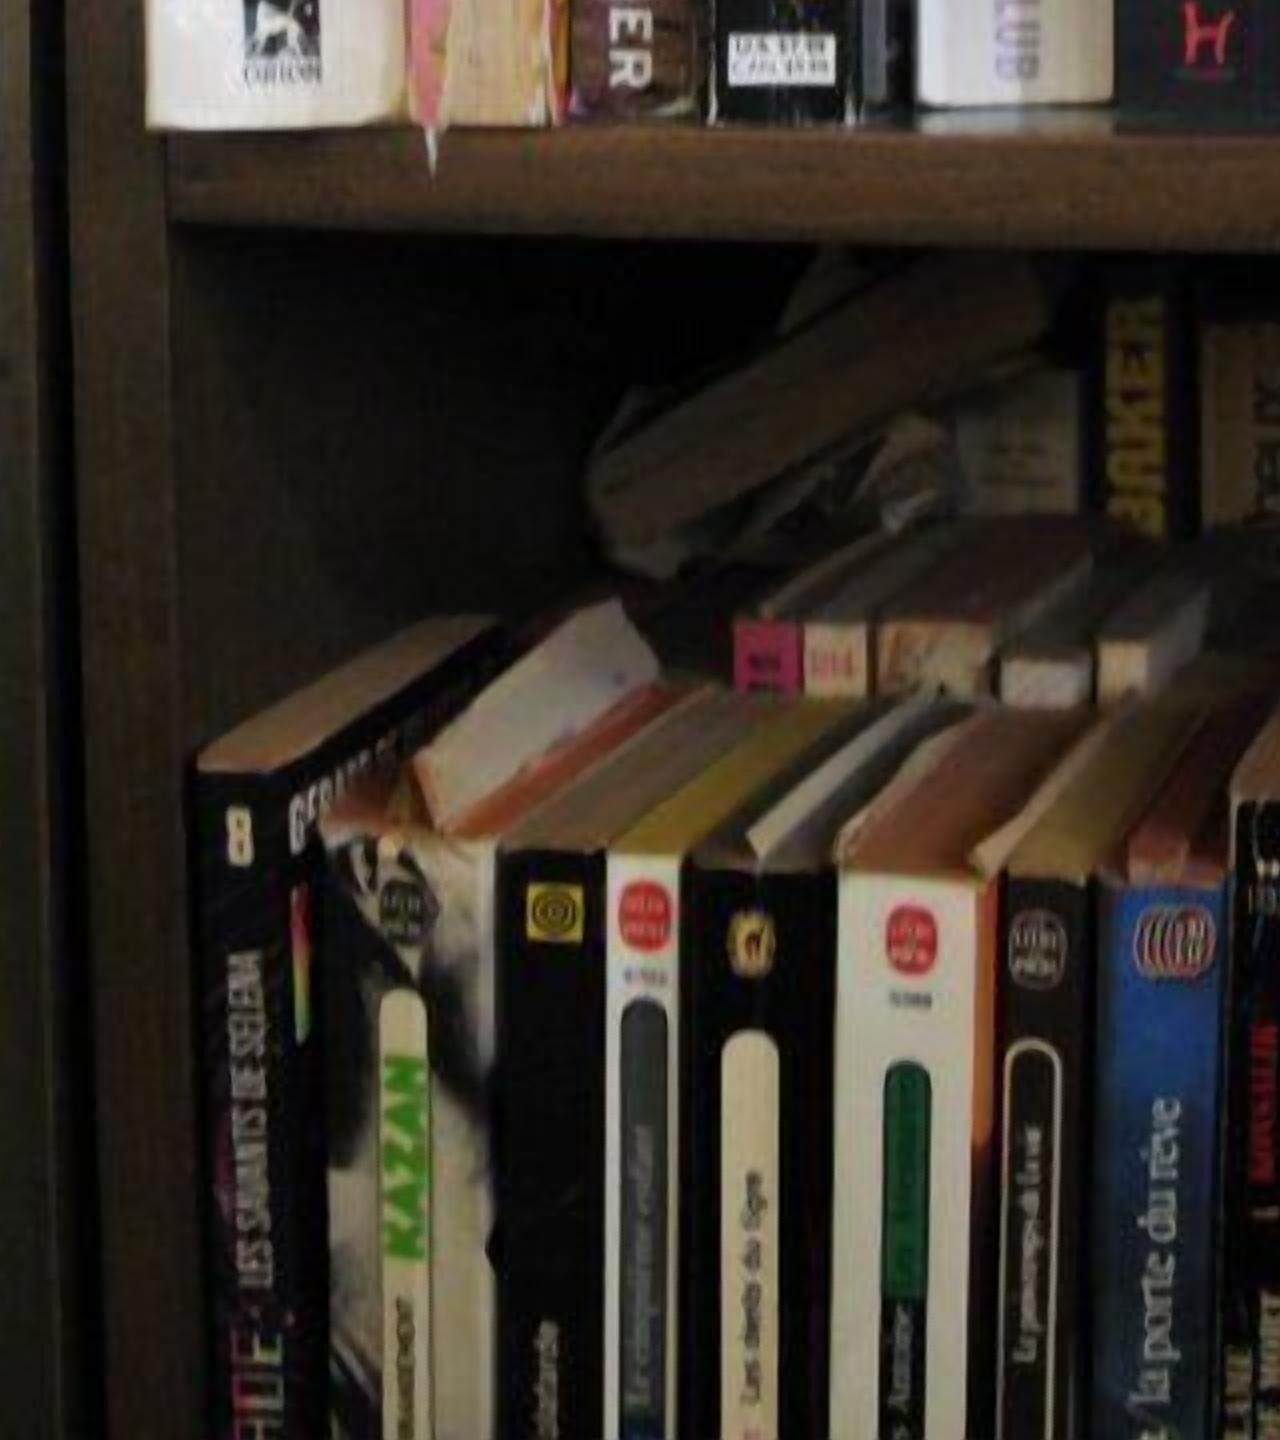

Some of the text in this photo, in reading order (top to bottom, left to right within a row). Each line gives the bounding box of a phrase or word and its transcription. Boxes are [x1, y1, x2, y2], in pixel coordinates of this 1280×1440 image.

[382, 1055, 426, 1260] KAZAN
[1142, 1097, 1182, 1180] rêve
[1138, 1190, 1182, 1242] du
[1136, 1251, 1181, 1360] porte
